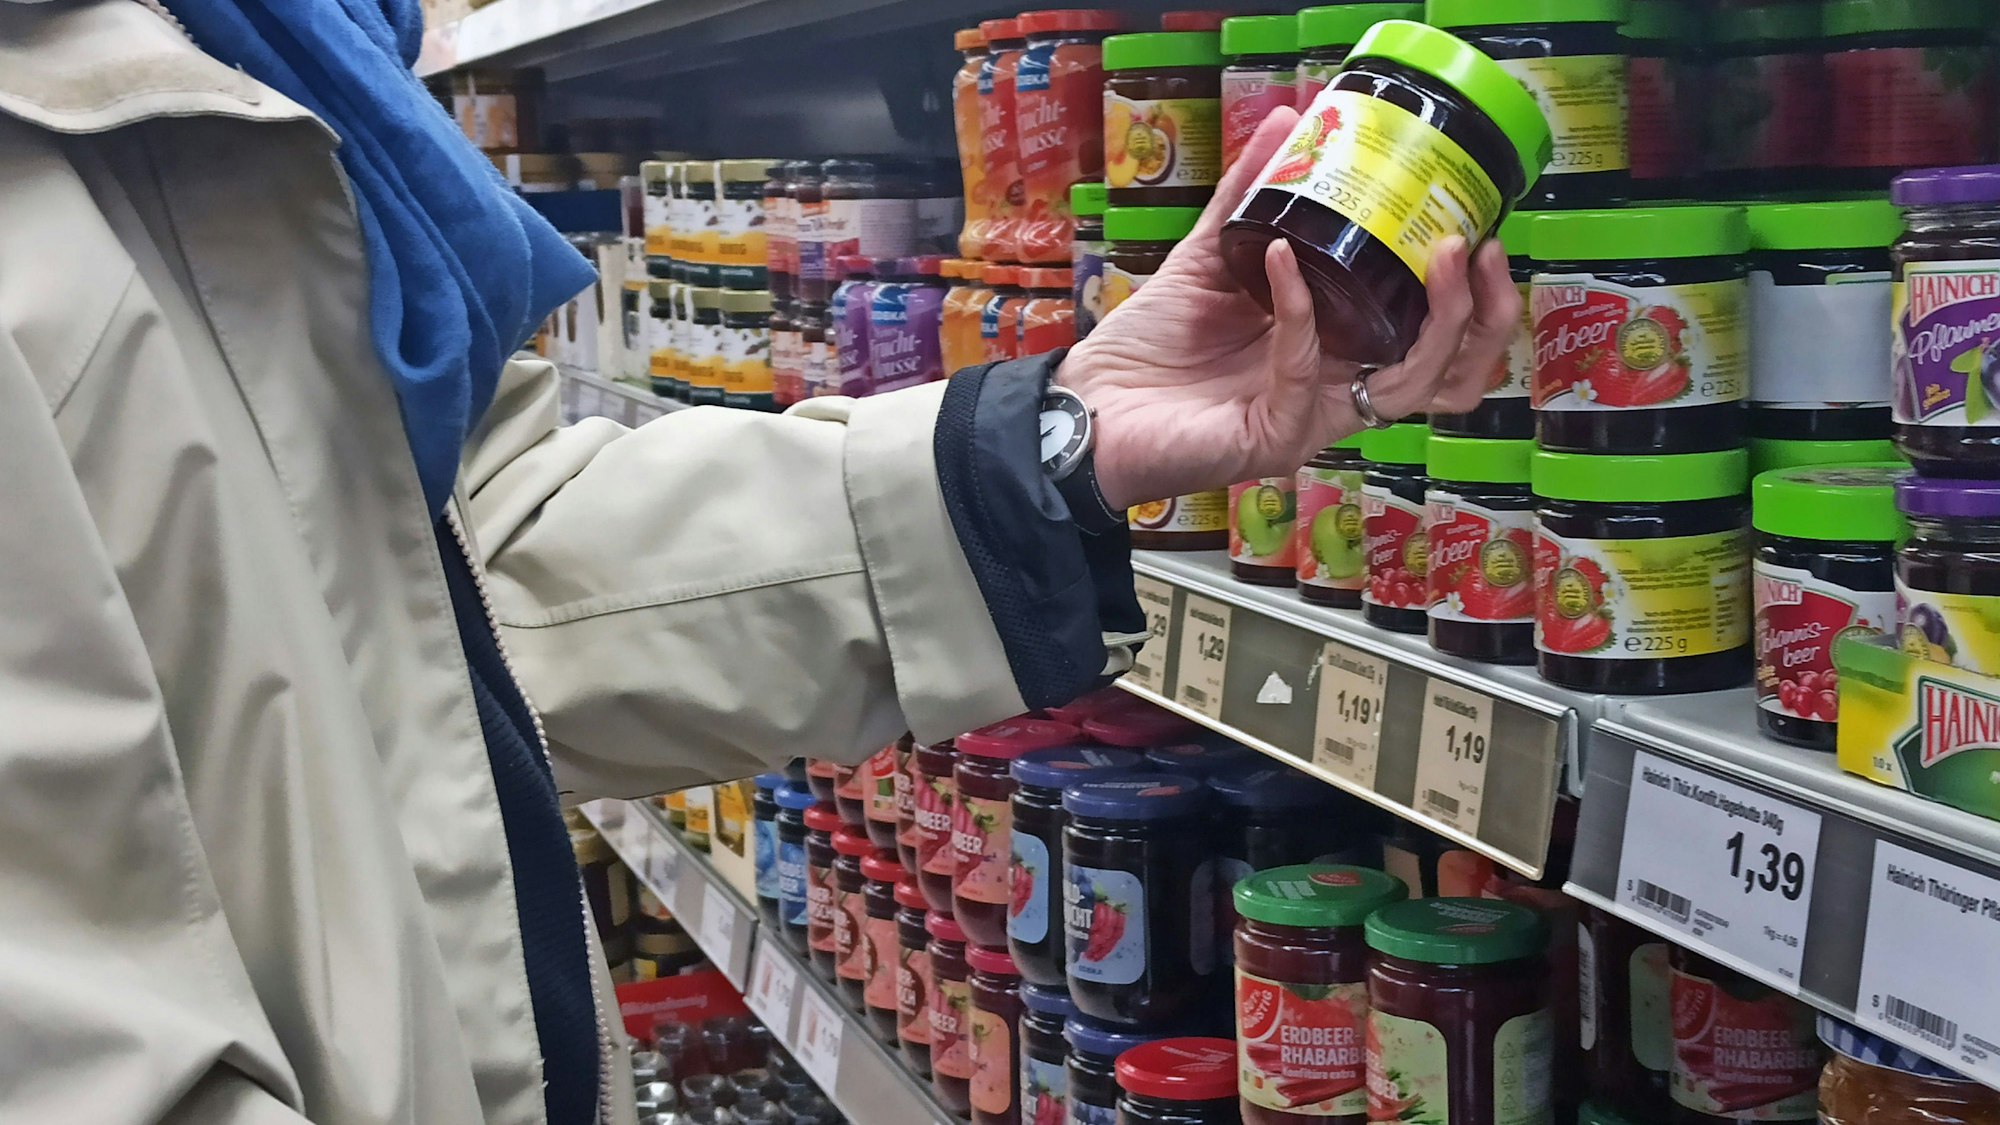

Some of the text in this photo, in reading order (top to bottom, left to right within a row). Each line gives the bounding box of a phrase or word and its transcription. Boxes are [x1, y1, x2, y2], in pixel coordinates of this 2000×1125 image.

[1568, 151, 1592, 166] 225
[1328, 186, 1360, 212] 225
[1357, 206, 1372, 223] g
[1911, 275, 1998, 326] HAINICH
[1534, 319, 1619, 372] Erdbeer
[1191, 514, 1211, 526] 225
[1198, 632, 1225, 662] 1,29
[1644, 635, 1674, 652] 225
[1676, 637, 1688, 653] g
[1782, 646, 1820, 668] beer
[1337, 690, 1371, 725] 1,19
[1923, 684, 2000, 763] HAINI
[1446, 725, 1486, 764] 1,19
[1726, 831, 1805, 901] 1,39
[1887, 863, 1927, 893] Hainich
[1927, 877, 1981, 914] Thüringer
[1280, 1025, 1361, 1045] ERDBEER-
